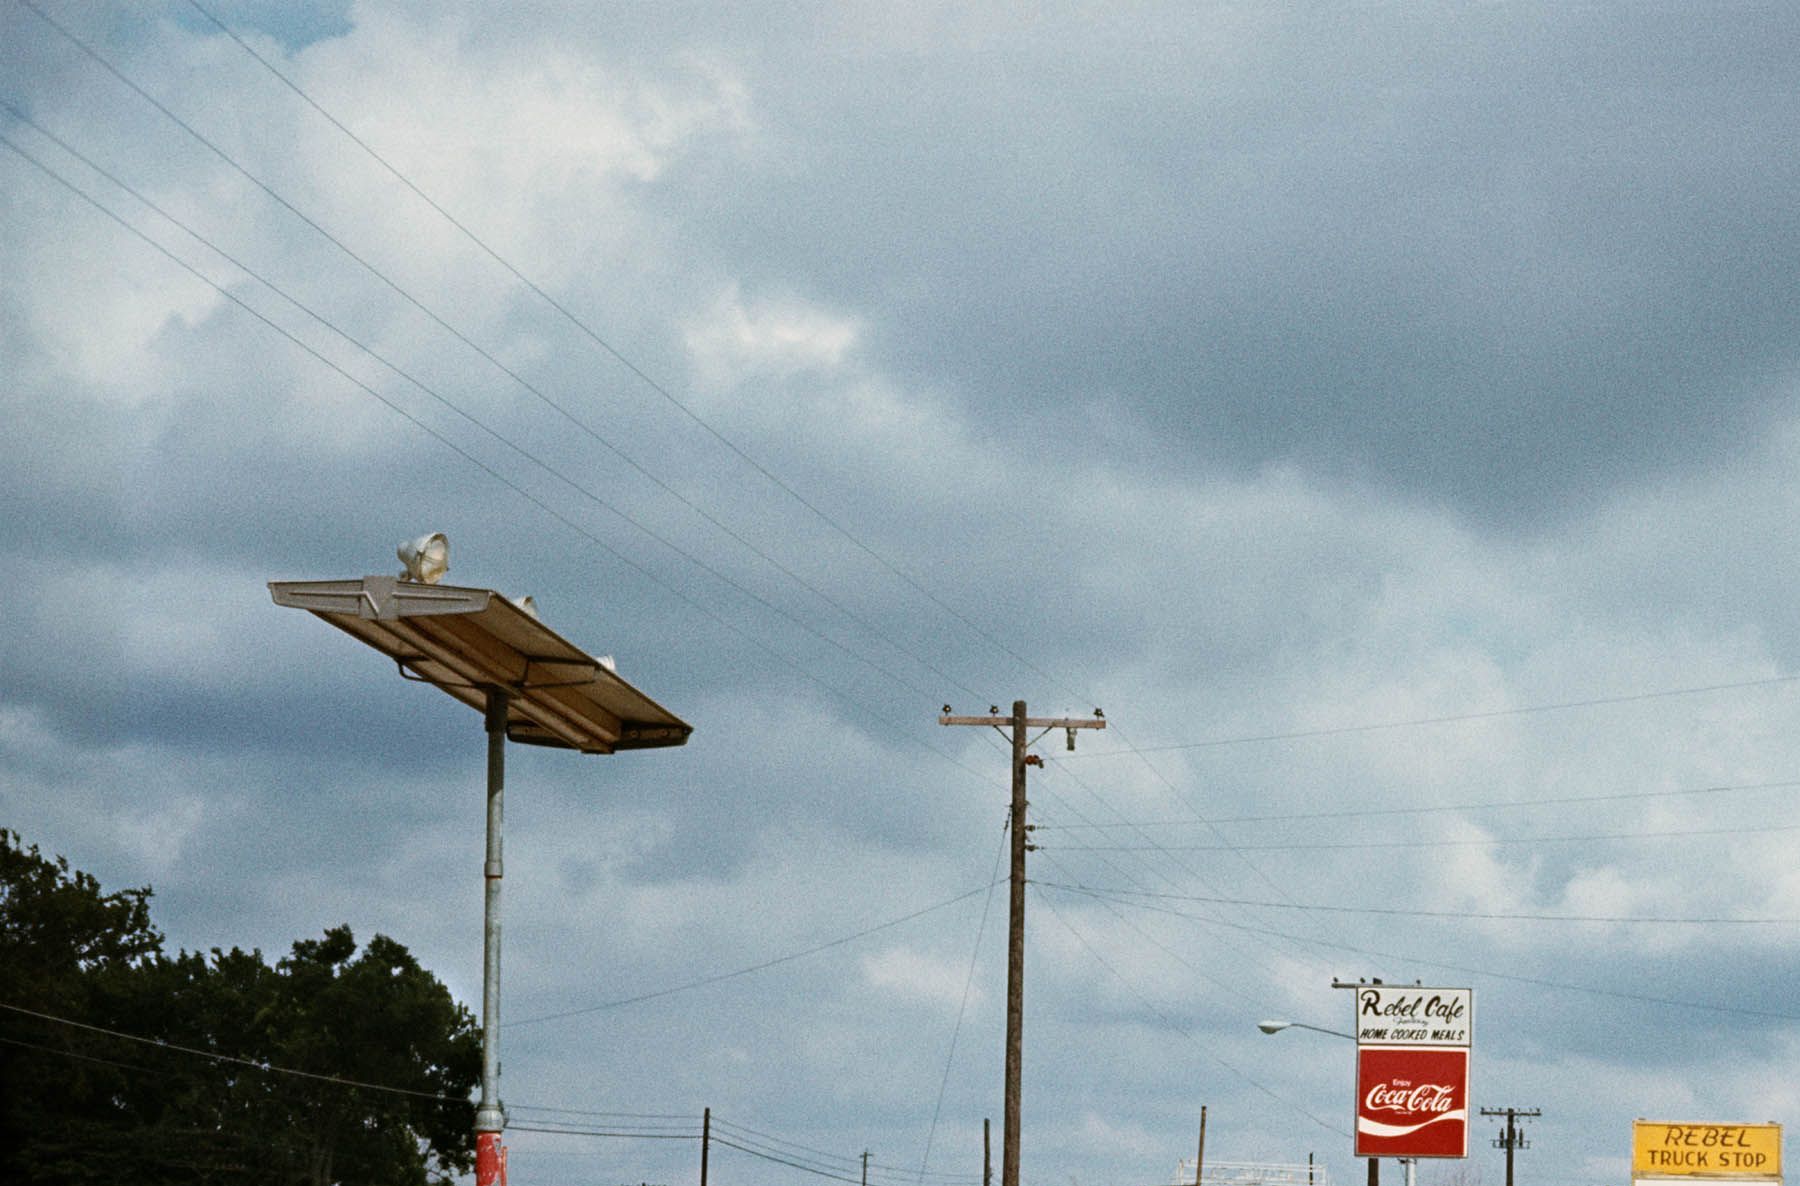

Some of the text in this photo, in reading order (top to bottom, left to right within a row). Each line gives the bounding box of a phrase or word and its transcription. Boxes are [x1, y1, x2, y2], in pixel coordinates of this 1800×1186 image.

[1360, 989, 1465, 1024] Rebel Cafe
[1359, 1028, 1465, 1041] HOME COOKED MEALS
[1392, 1078, 1412, 1087] Enjoy
[1366, 1083, 1456, 1112] Coca-Cola
[1664, 1126, 1751, 1147] REBEL
[1647, 1150, 1766, 1167] TRUCK STOP
